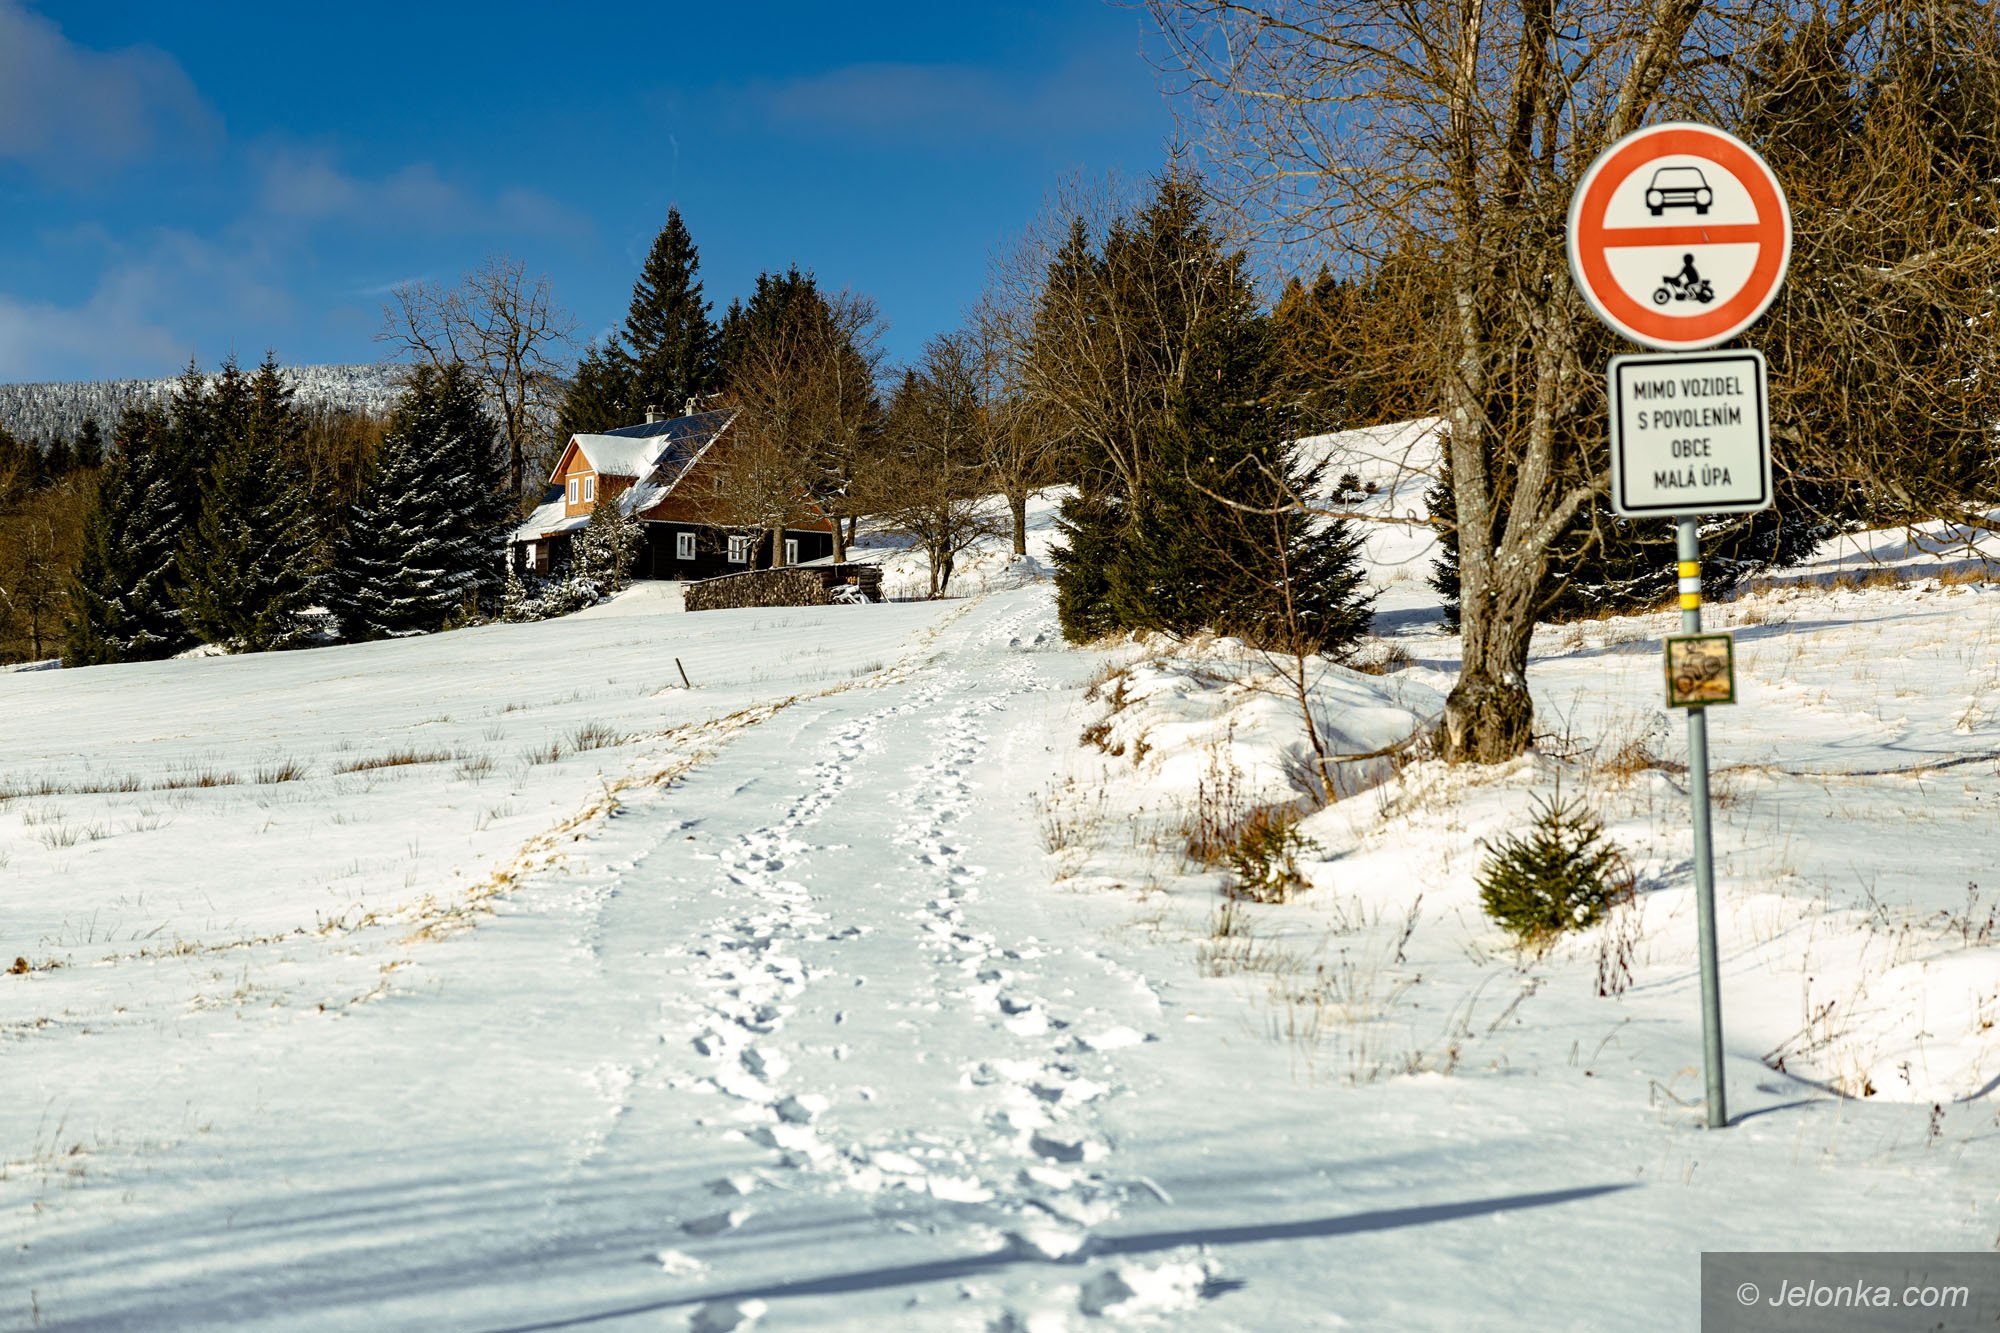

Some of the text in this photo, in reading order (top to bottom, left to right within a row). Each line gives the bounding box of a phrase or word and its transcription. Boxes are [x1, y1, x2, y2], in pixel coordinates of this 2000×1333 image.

[1634, 376, 1743, 400] MIMO VOZIDEL
[1638, 403, 1741, 430] S POVOLENÍM
[1672, 438, 1711, 458] OBCE
[1654, 463, 1732, 489] MALÁ ÚPA
